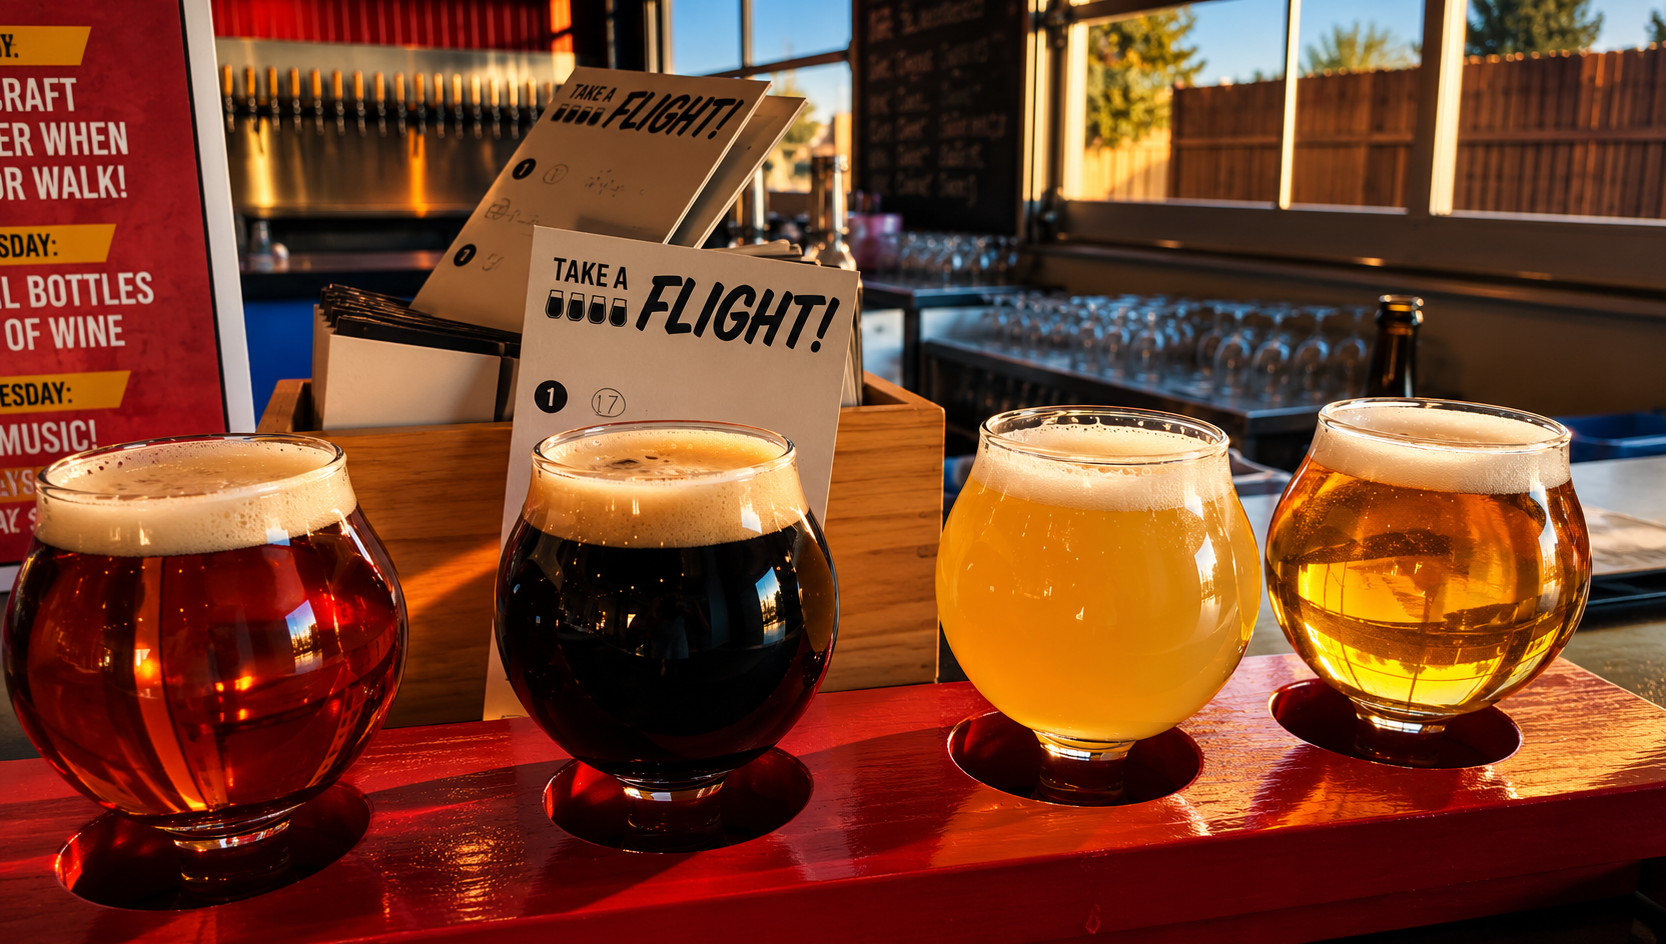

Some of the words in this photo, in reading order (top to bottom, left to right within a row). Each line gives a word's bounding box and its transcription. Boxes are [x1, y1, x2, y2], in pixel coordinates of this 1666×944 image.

[0, 77, 77, 112] RAFT
[569, 83, 608, 102] TAKE
[602, 87, 617, 102] A
[601, 91, 745, 140] FLIGHT!
[39, 121, 129, 156] WHEN
[0, 166, 26, 201] R
[31, 164, 128, 200] WALK!
[0, 233, 58, 258] SDAY:
[0, 275, 20, 310] L
[26, 271, 155, 309] BOTTLES
[553, 256, 610, 287] TAKE
[613, 266, 628, 290] A
[635, 275, 840, 353] FLIGHT!
[4, 317, 41, 352] OF
[48, 314, 126, 350] WINE
[0, 381, 73, 408] ESDAY:
[0, 419, 98, 456] MUSIC!
